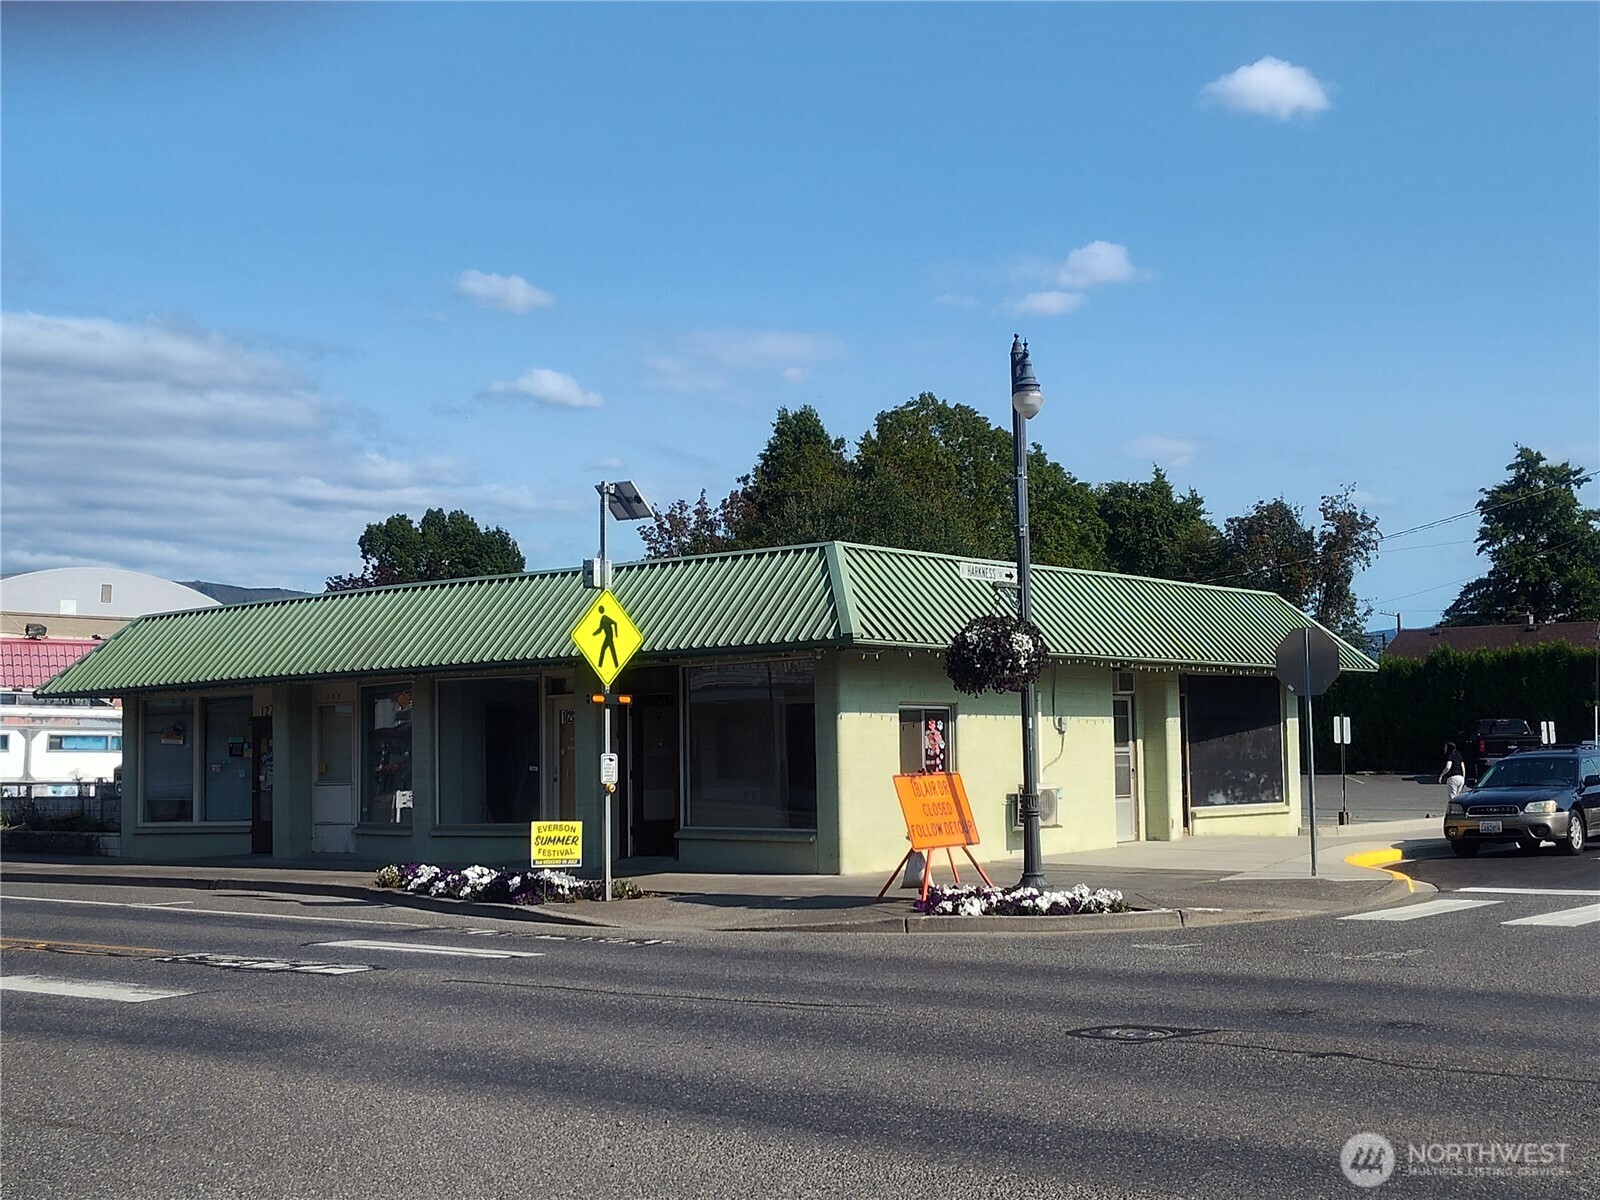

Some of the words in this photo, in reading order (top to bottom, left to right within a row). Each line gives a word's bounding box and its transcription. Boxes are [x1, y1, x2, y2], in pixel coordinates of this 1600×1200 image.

[967, 565, 996, 580] HARKNESS
[913, 781, 939, 798] BLAIR
[922, 802, 953, 817] CLOSED
[537, 824, 577, 834] EVERSON
[911, 822, 944, 838] FOLLOW
[943, 820, 975, 835] DETOUR
[534, 835, 579, 846] SUMMER
[537, 848, 575, 857] FESTIVAL
